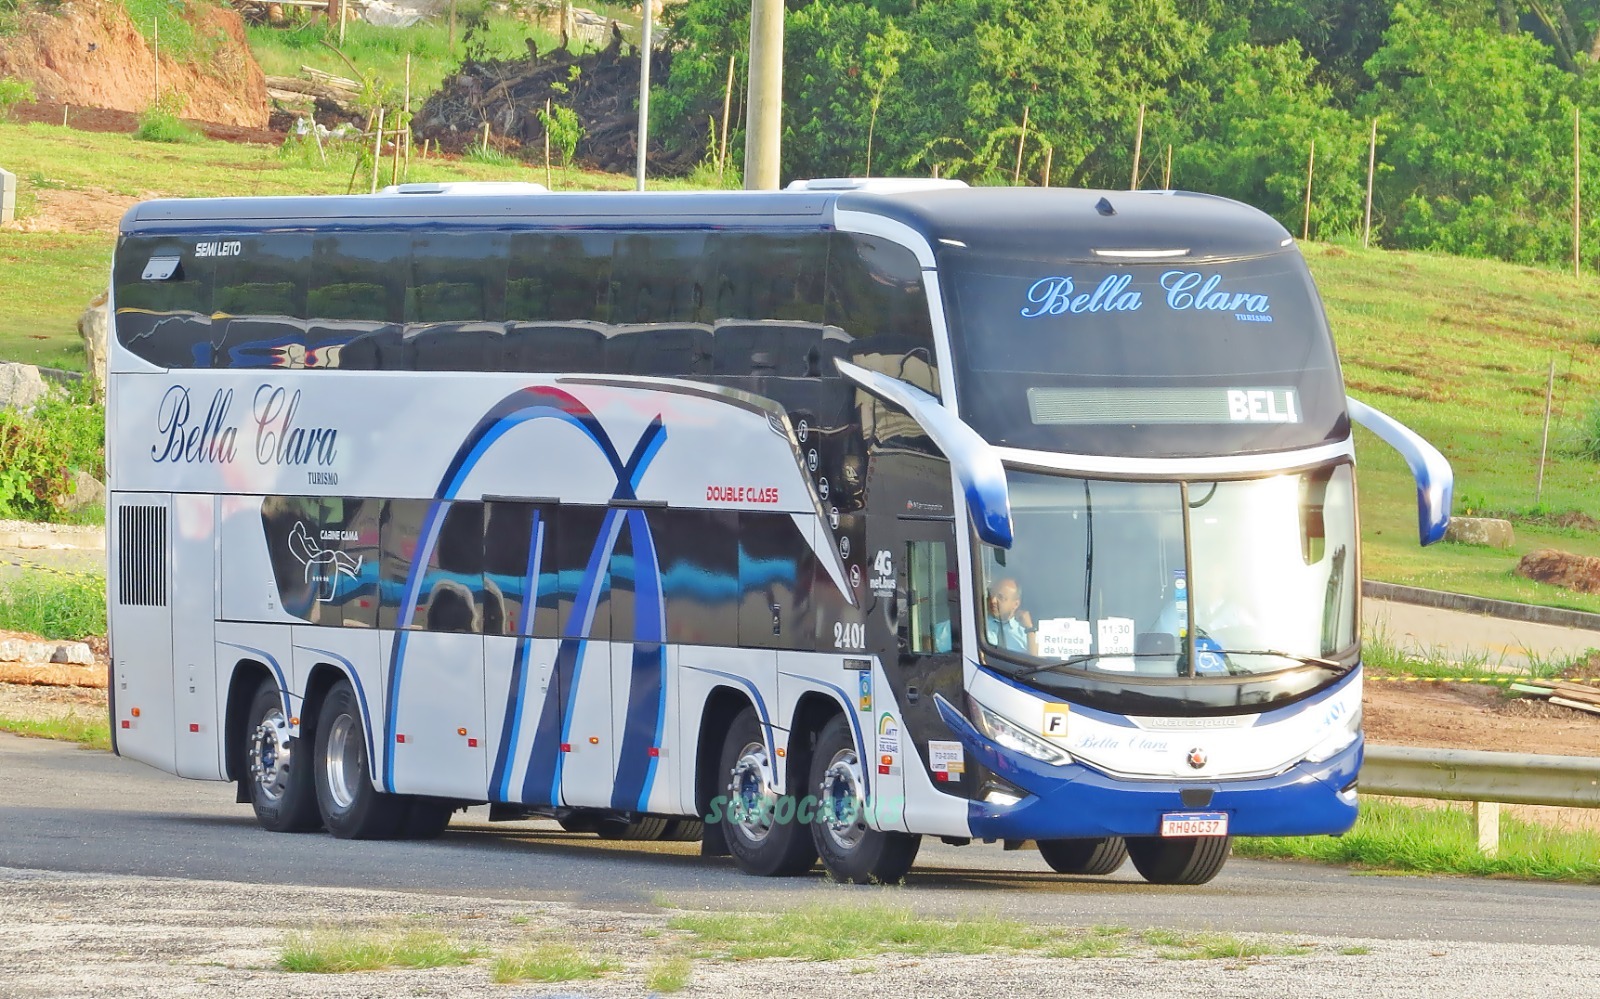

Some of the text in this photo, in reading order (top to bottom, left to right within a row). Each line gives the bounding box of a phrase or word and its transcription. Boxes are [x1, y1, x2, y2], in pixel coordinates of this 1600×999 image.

[195, 241, 241, 257] SEMI LEITO
[1020, 270, 1270, 318] Bella Clara
[1235, 313, 1273, 322] TURISMO
[151, 384, 338, 466] Bella Clara
[307, 471, 339, 486] TURISMO
[706, 486, 778, 504] DOUBLE CLASS
[320, 529, 359, 542] CABINE CAMA
[874, 550, 892, 576] 4G
[834, 622, 866, 649] 2401
[1103, 624, 1130, 634] 11:30
[1044, 635, 1085, 645] Retirada
[1113, 635, 1119, 644] 9
[1044, 646, 1084, 655] de Vasos
[1049, 716, 1062, 732] F
[1151, 718, 1237, 728] Marcopolo
[1075, 734, 1169, 750] Bella Clara
[1169, 821, 1219, 834] RHQ6C37
